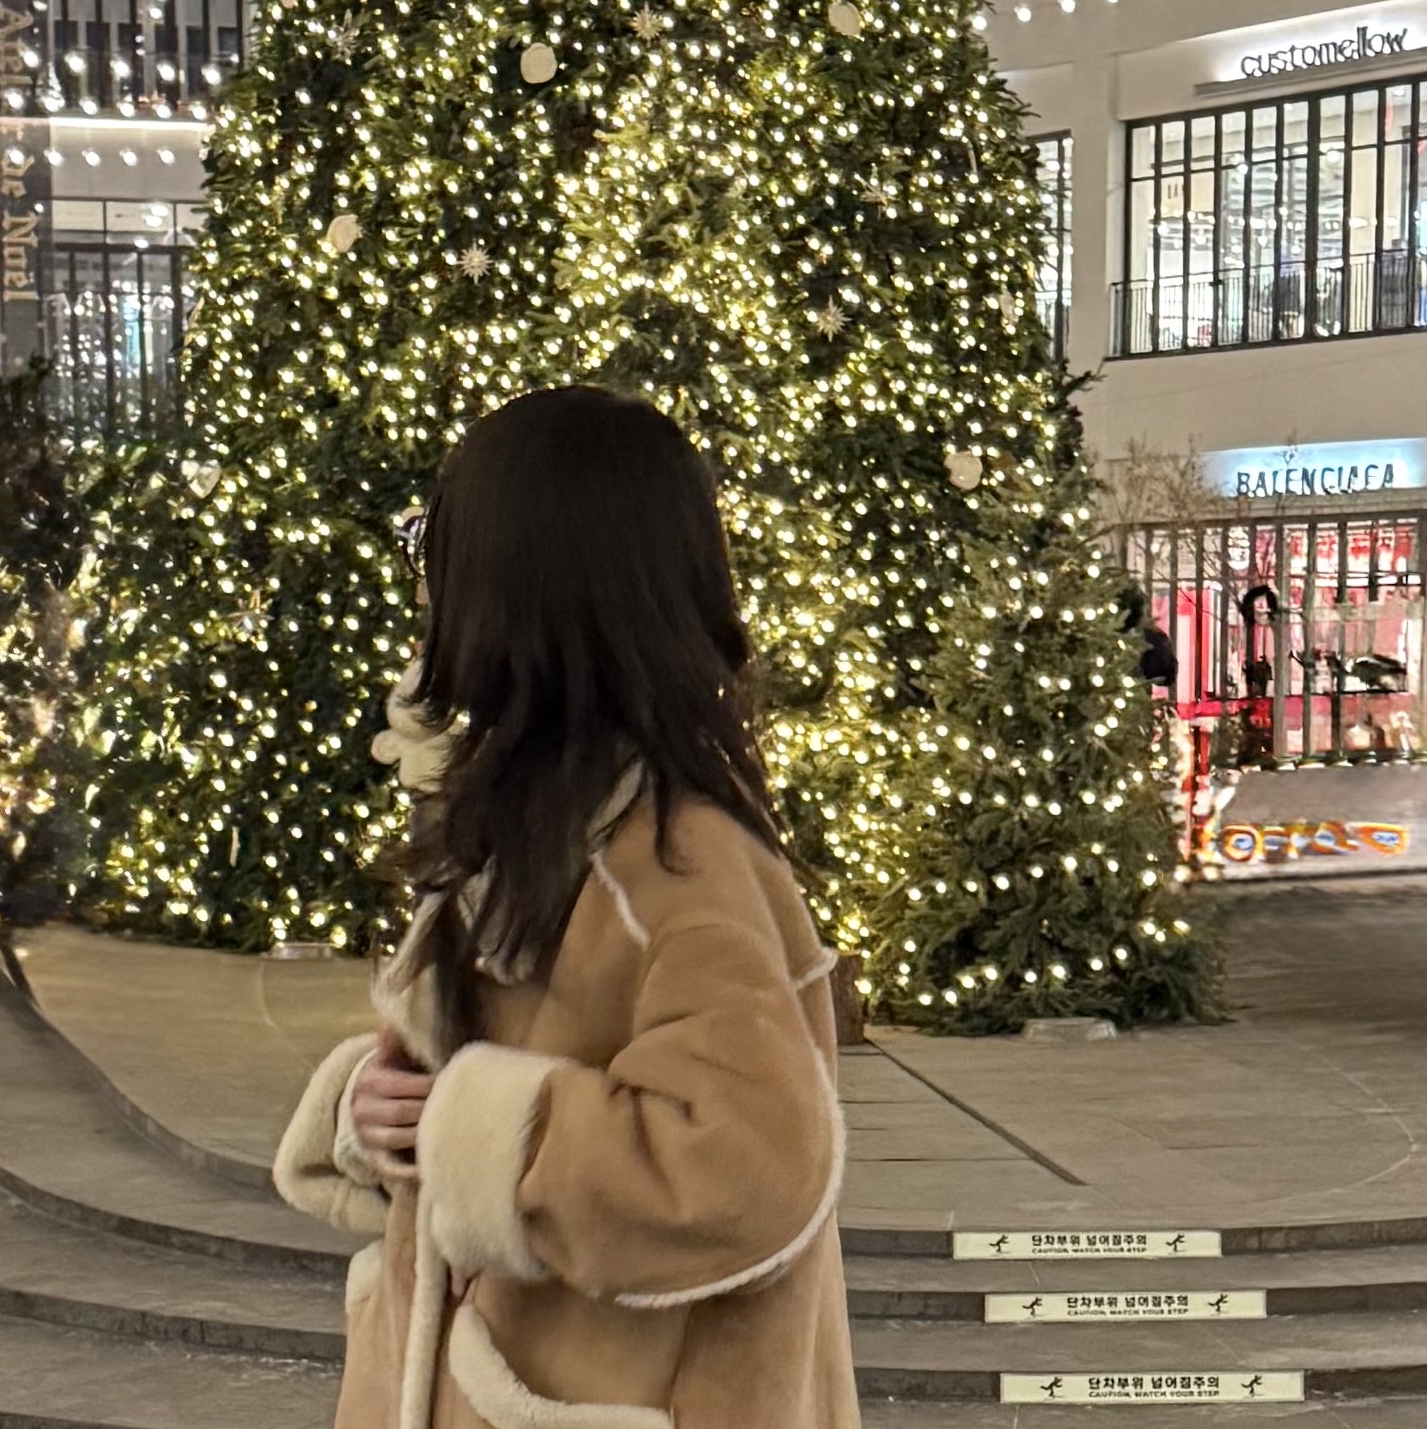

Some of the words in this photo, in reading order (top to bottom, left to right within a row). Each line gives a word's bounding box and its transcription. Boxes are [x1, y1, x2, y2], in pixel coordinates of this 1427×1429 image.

[1240, 25, 1408, 76] customellow
[1, 210, 41, 303] Noël
[1067, 1296, 1118, 1308] 단차부위
[1125, 1295, 1188, 1307] 넘어짐주의
[1088, 1377, 1144, 1390] 단차부위
[1151, 1376, 1219, 1389] 넘어짐주의
